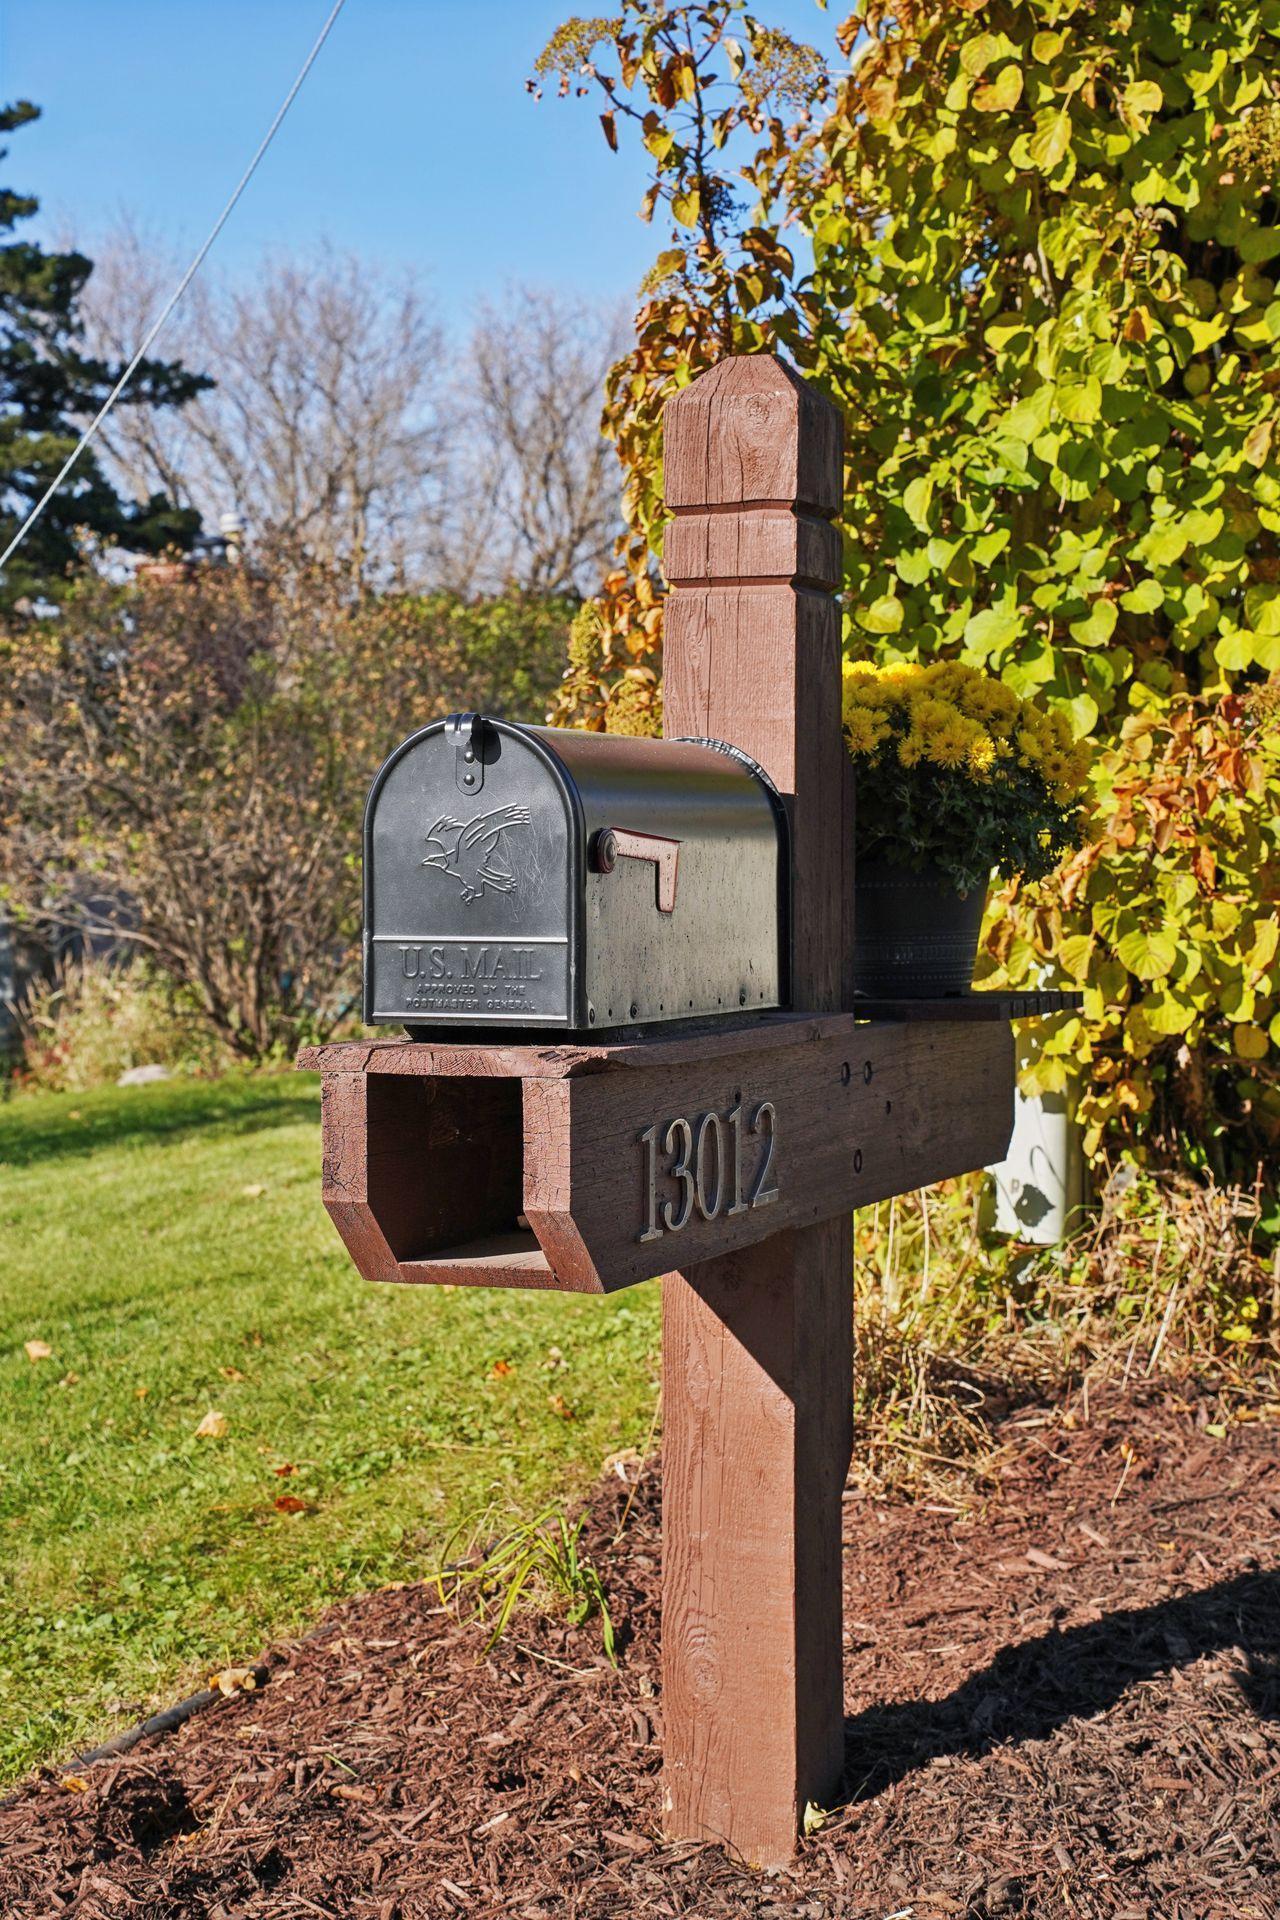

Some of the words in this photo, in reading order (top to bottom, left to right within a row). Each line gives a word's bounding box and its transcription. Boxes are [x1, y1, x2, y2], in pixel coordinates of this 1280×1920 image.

[398, 945, 453, 979] U.S.
[460, 945, 543, 980] MAIL
[417, 984, 476, 995] APPROVED
[483, 985, 497, 996] BY
[504, 985, 526, 996] THE
[406, 997, 480, 1010] POSTMASTER
[487, 999, 536, 1011] GENERAL
[638, 1102, 779, 1242] 13012
